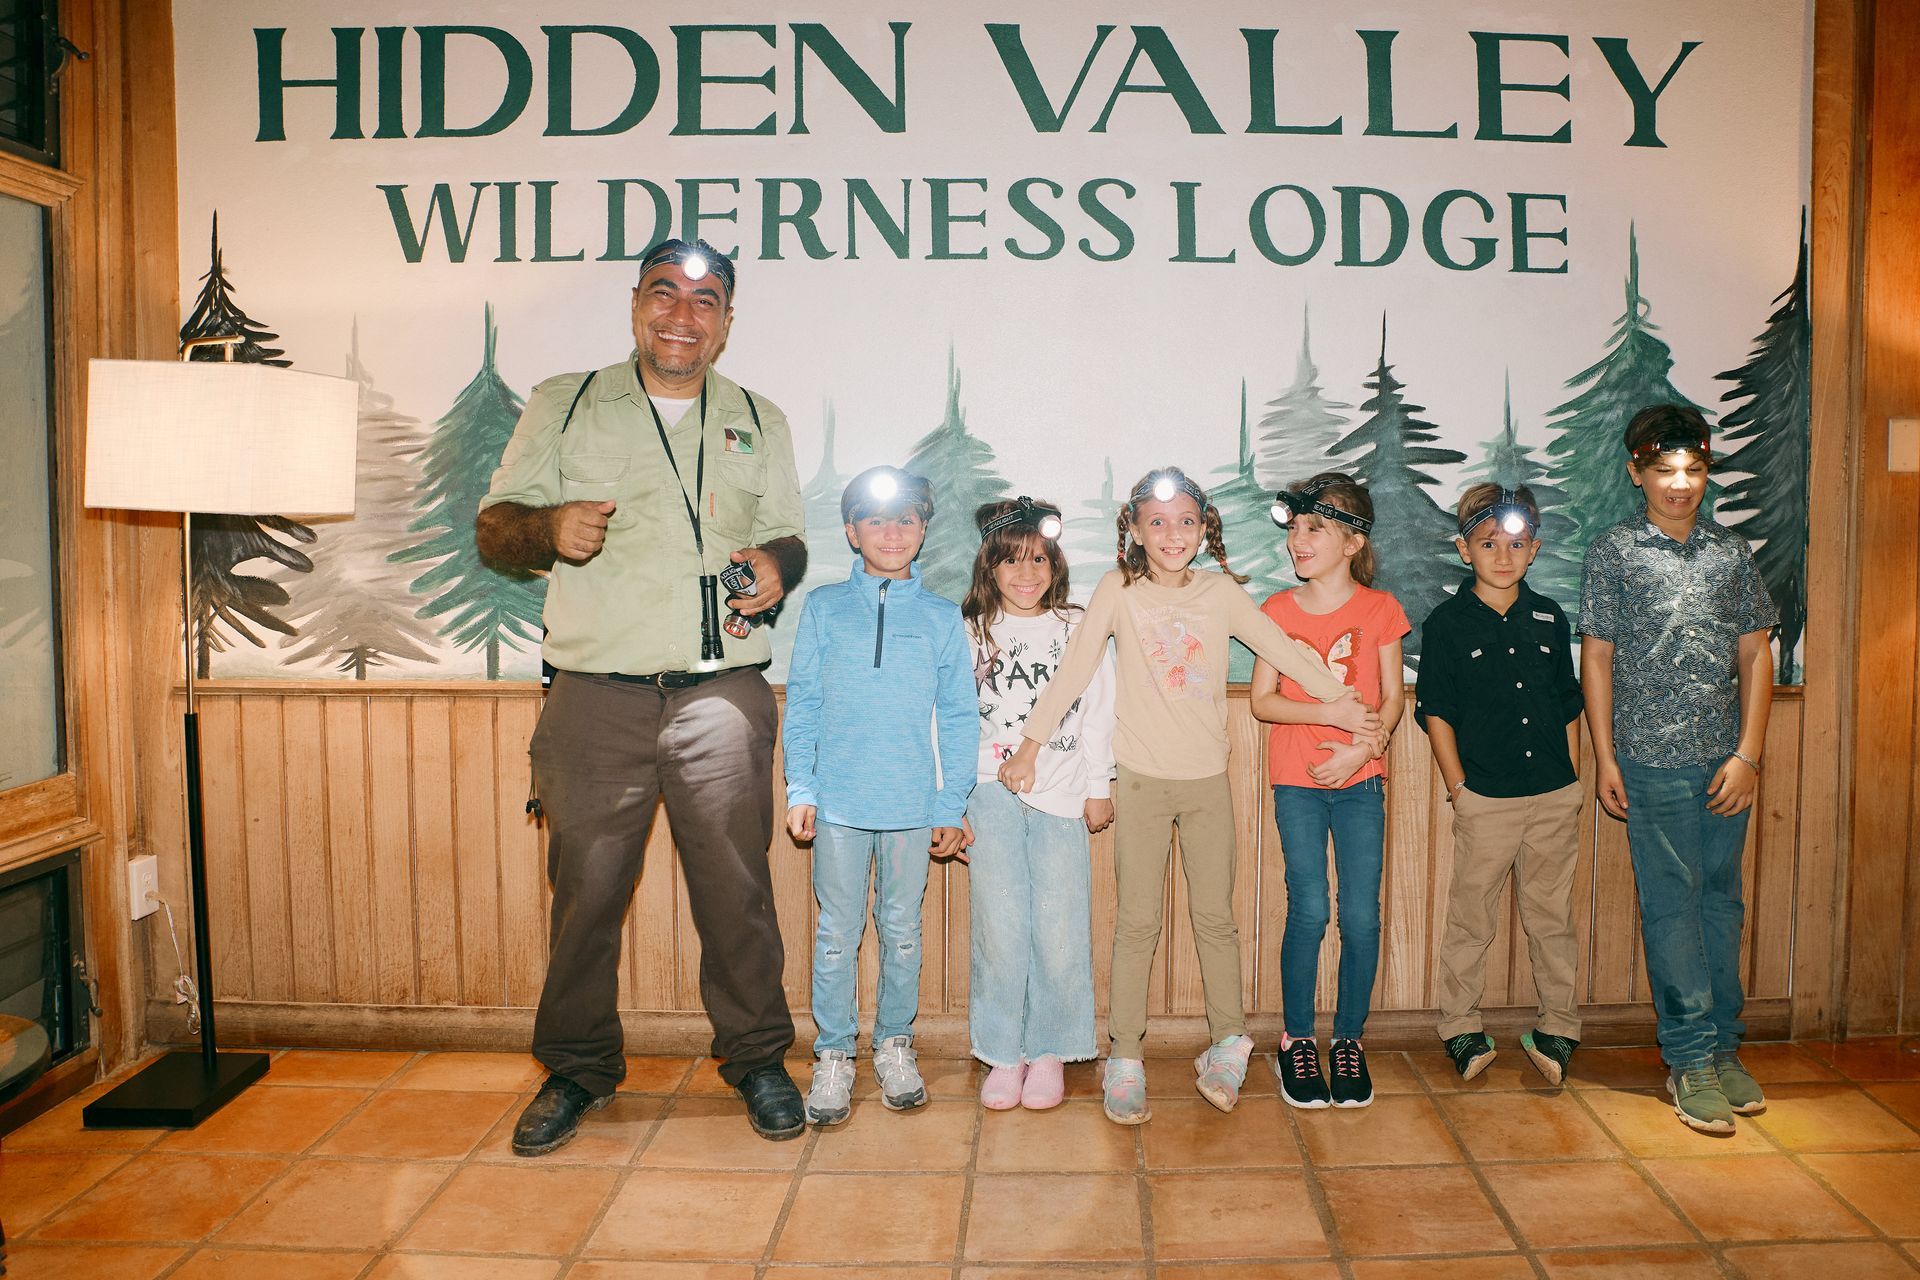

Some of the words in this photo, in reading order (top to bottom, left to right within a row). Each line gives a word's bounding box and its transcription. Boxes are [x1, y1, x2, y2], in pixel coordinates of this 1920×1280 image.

[253, 22, 912, 142] HIDDEN
[984, 23, 1704, 148] VALLEY
[376, 177, 1137, 263] WILDERNESS
[1168, 181, 1569, 274] LODGE
